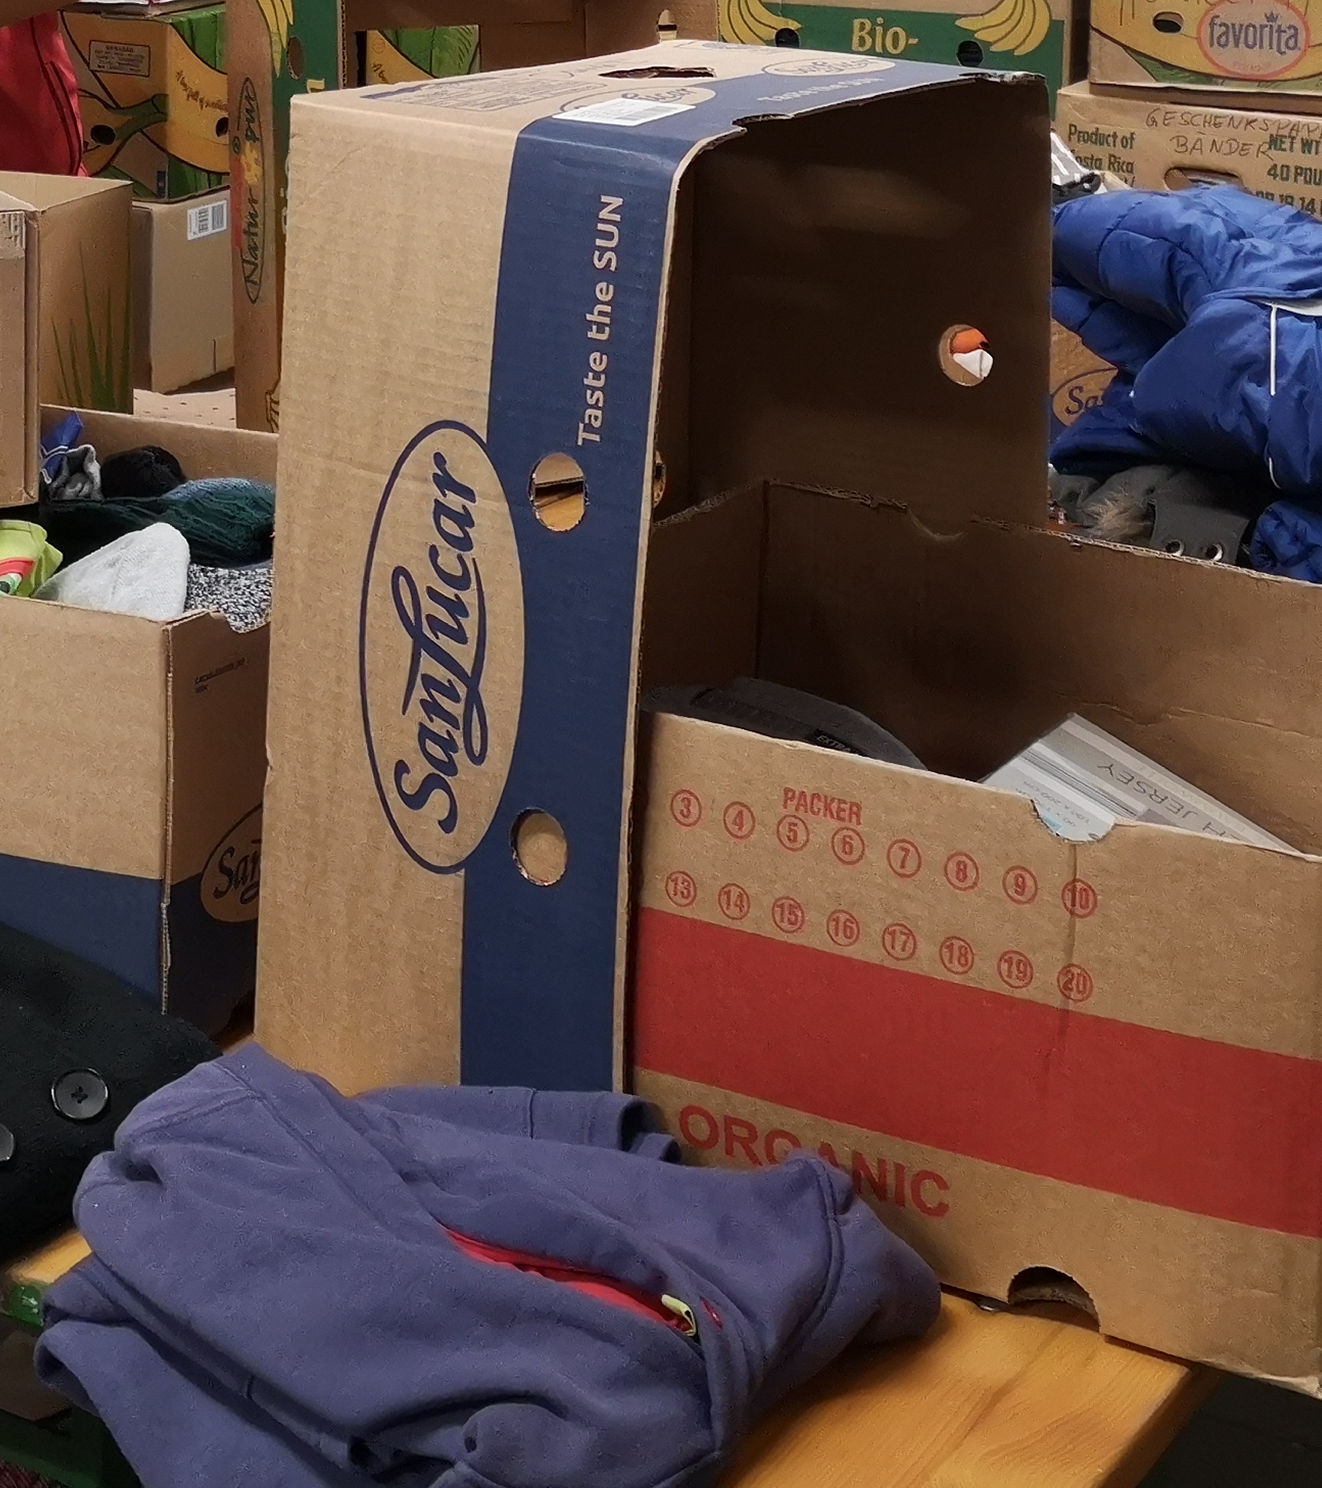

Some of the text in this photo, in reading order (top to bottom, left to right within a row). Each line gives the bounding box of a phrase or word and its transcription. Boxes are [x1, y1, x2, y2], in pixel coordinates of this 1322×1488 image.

[851, 16, 920, 55] Bio-
[1208, 14, 1303, 56] favorita
[1068, 123, 1136, 150] Product of
[1268, 133, 1322, 156] NET WT
[242, 85, 260, 286] Natur pur
[1107, 153, 1135, 175] Rica
[1267, 163, 1290, 180] 40
[578, 195, 624, 447] Taste the SUN
[390, 451, 489, 835] SanLucar
[782, 786, 863, 826] PACKER
[1097, 762, 1200, 821] JERSEY
[679, 796, 1090, 910] 3 4 5 6 7 8 9 10
[670, 876, 1088, 996] 13 14 15 16 17 18 19 20
[679, 1104, 951, 1217] ORNIC
